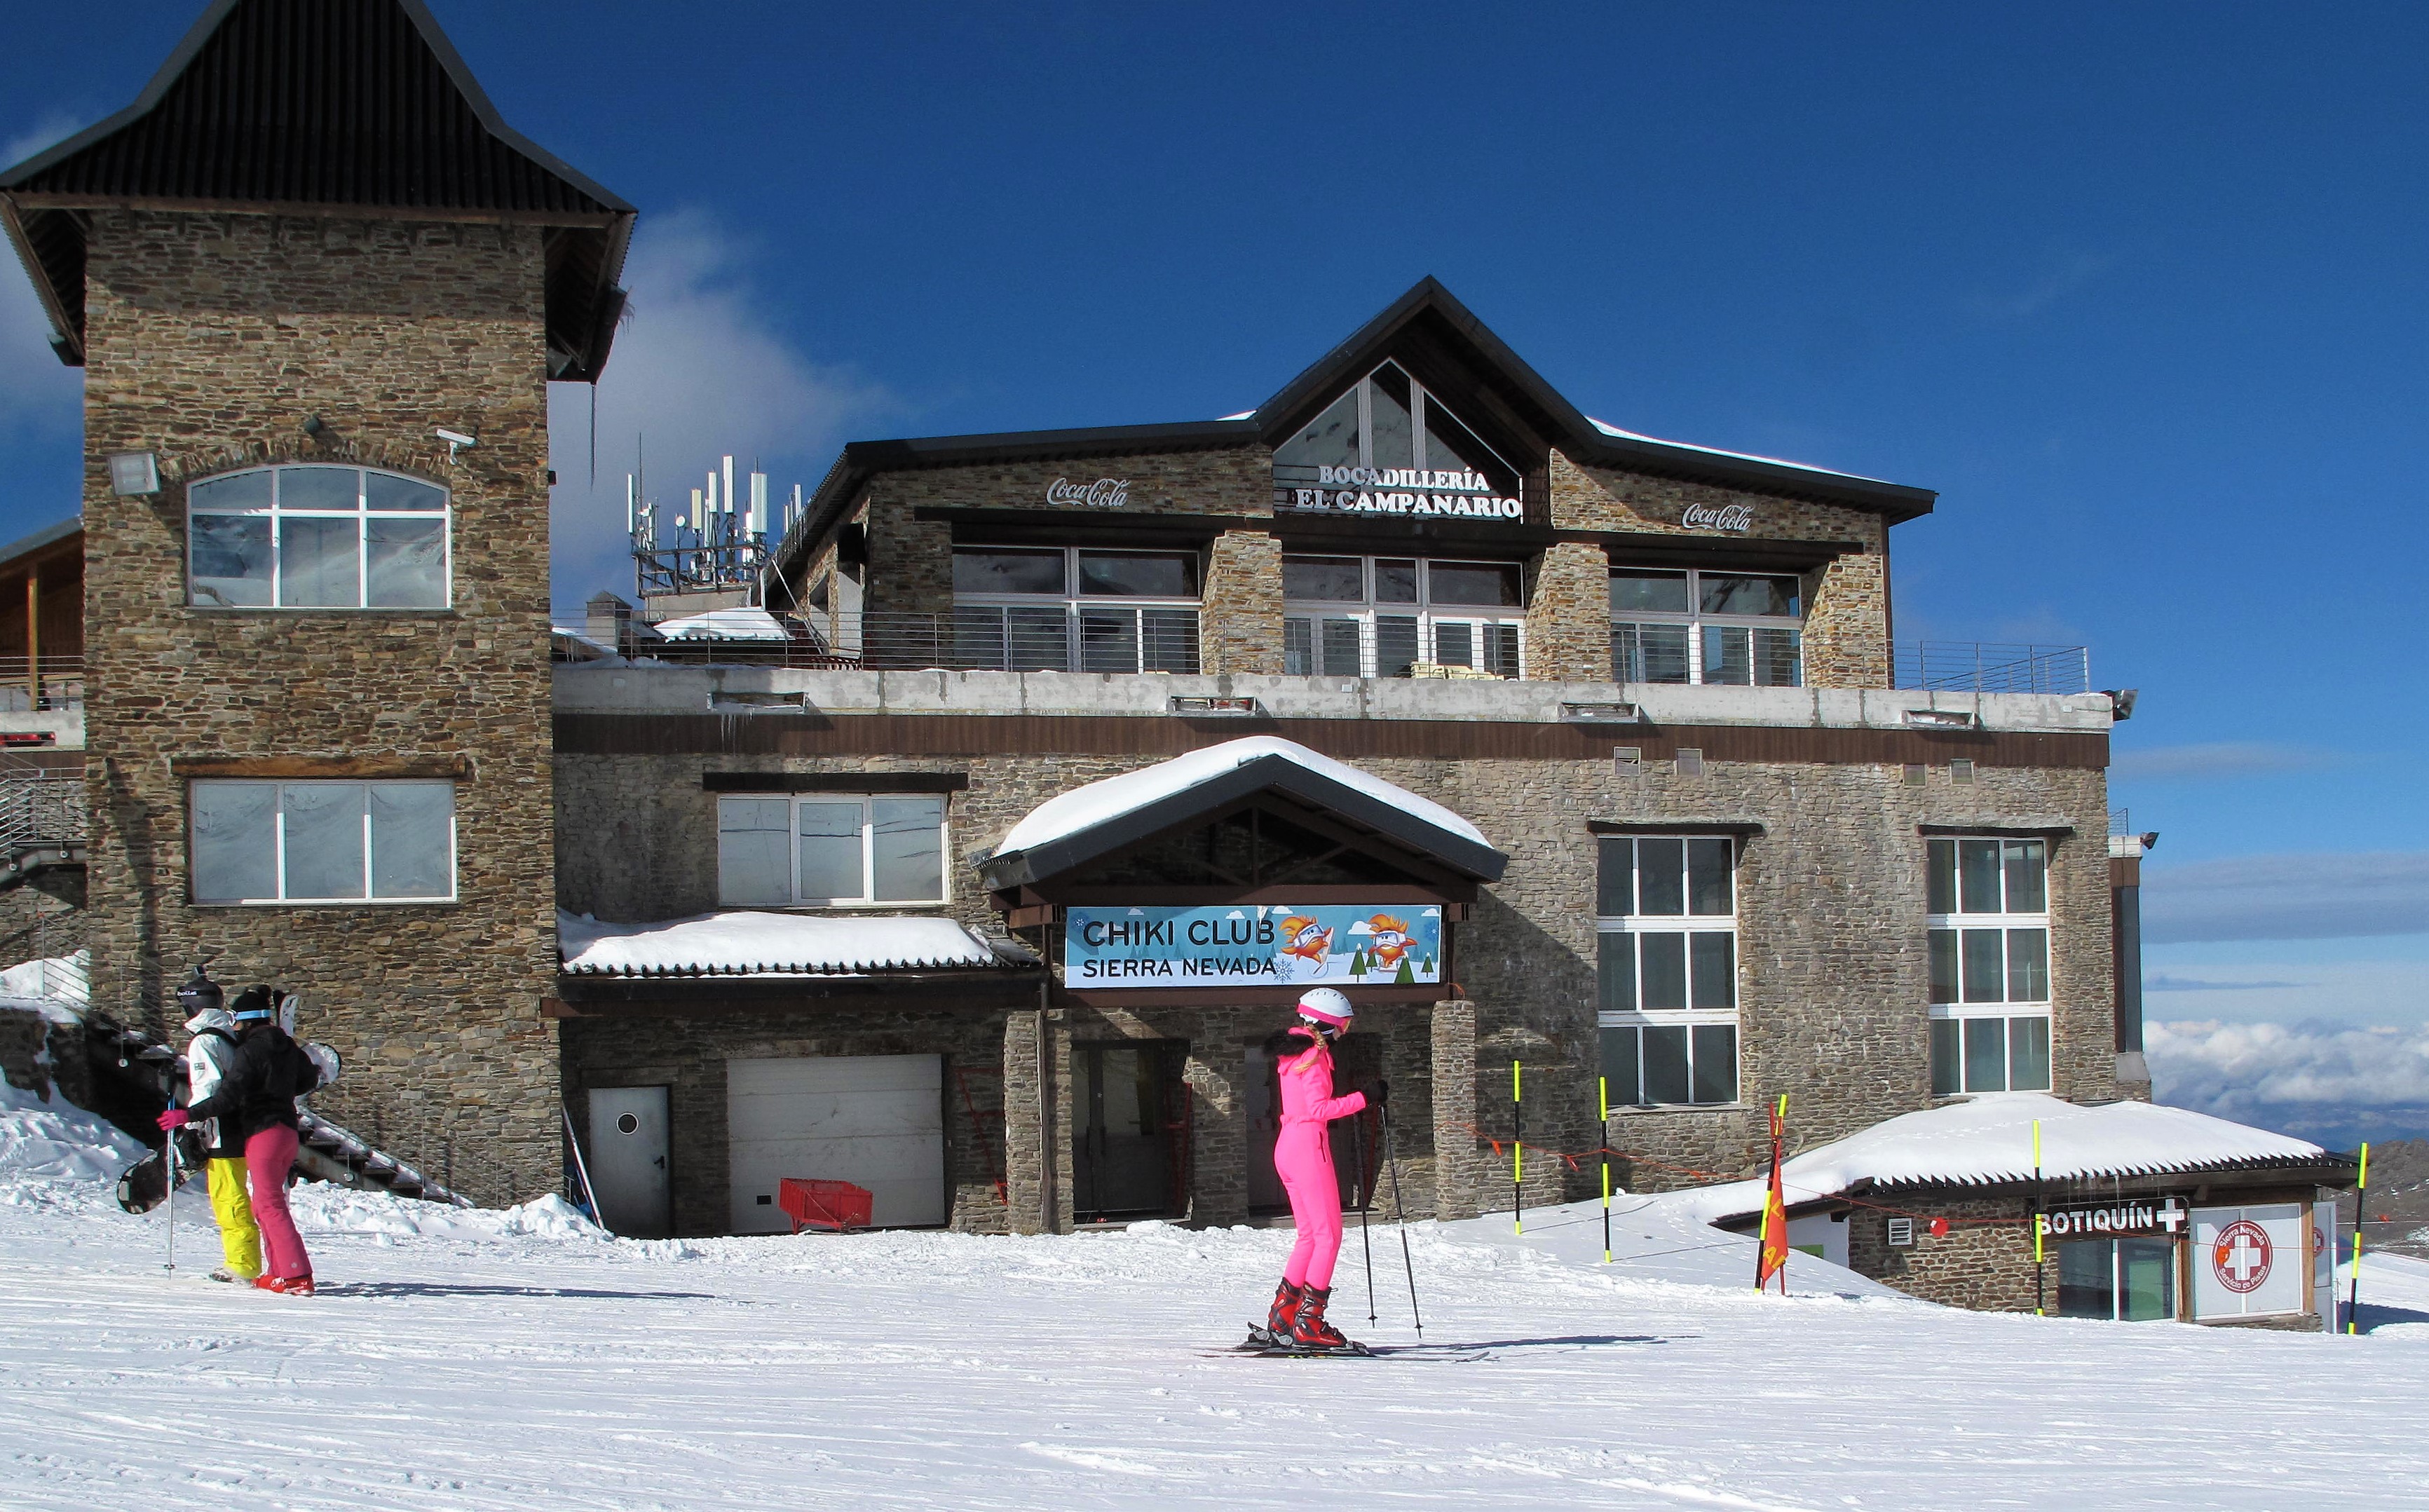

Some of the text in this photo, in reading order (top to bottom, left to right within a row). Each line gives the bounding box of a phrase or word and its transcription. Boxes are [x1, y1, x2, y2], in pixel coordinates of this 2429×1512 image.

[1319, 465, 1490, 491] BOCADILLERÍA
[1295, 489, 1520, 518] EL CAMPANARIO
[1083, 920, 1274, 946] CHIKI CLUB
[1082, 957, 1277, 977] SIERRA NEVADA
[2041, 1201, 2153, 1235] BOTIQUÍN
[2219, 1225, 2265, 1246] Sierra Nevada
